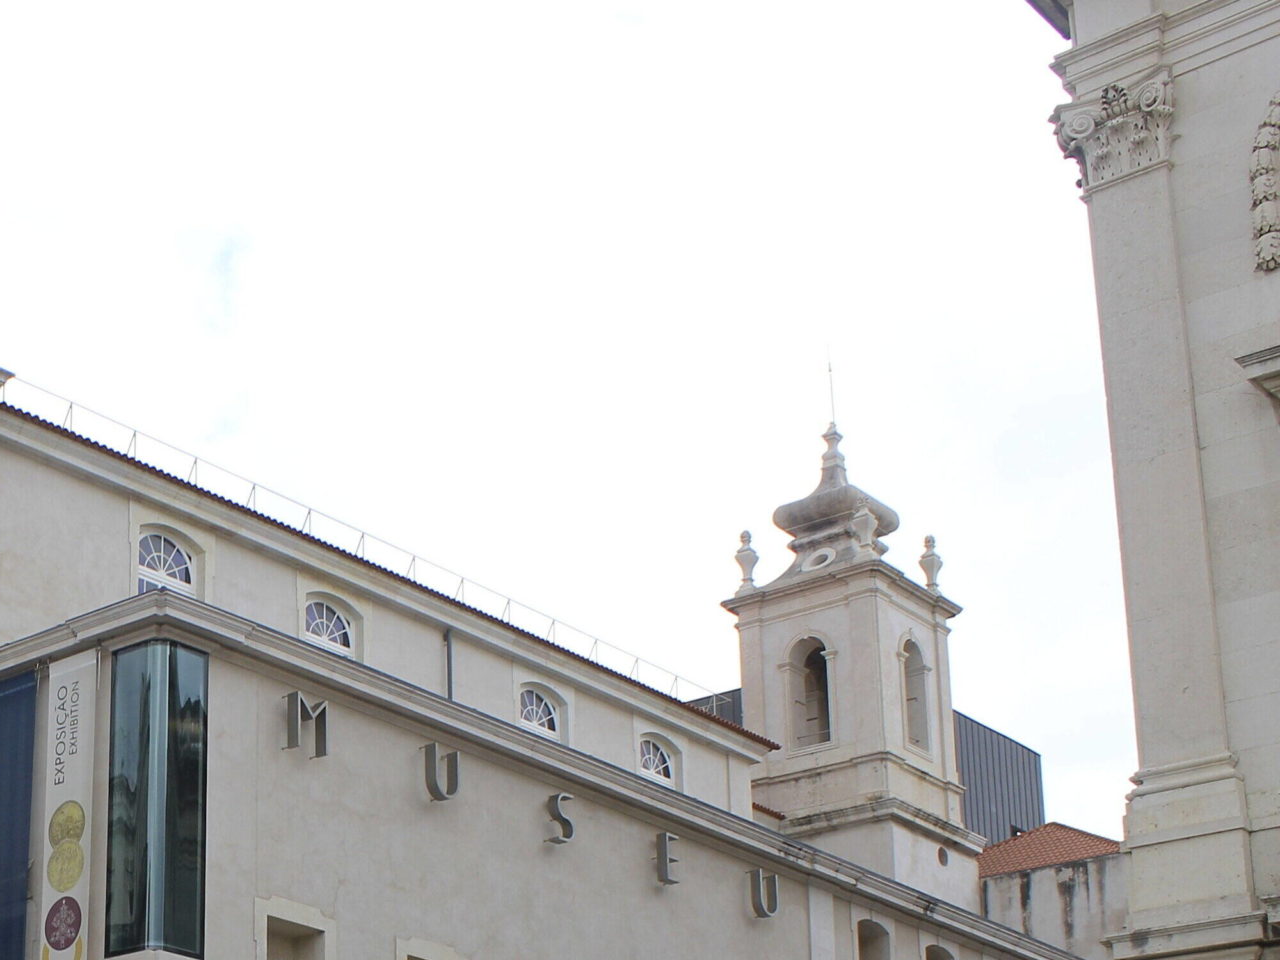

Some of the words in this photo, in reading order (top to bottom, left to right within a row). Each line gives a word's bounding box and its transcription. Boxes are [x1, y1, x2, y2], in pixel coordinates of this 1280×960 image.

[54, 685, 69, 786] EXPOSIÇÃO
[69, 680, 79, 756] EXHIBITION
[282, 690, 779, 918] MUSEU
